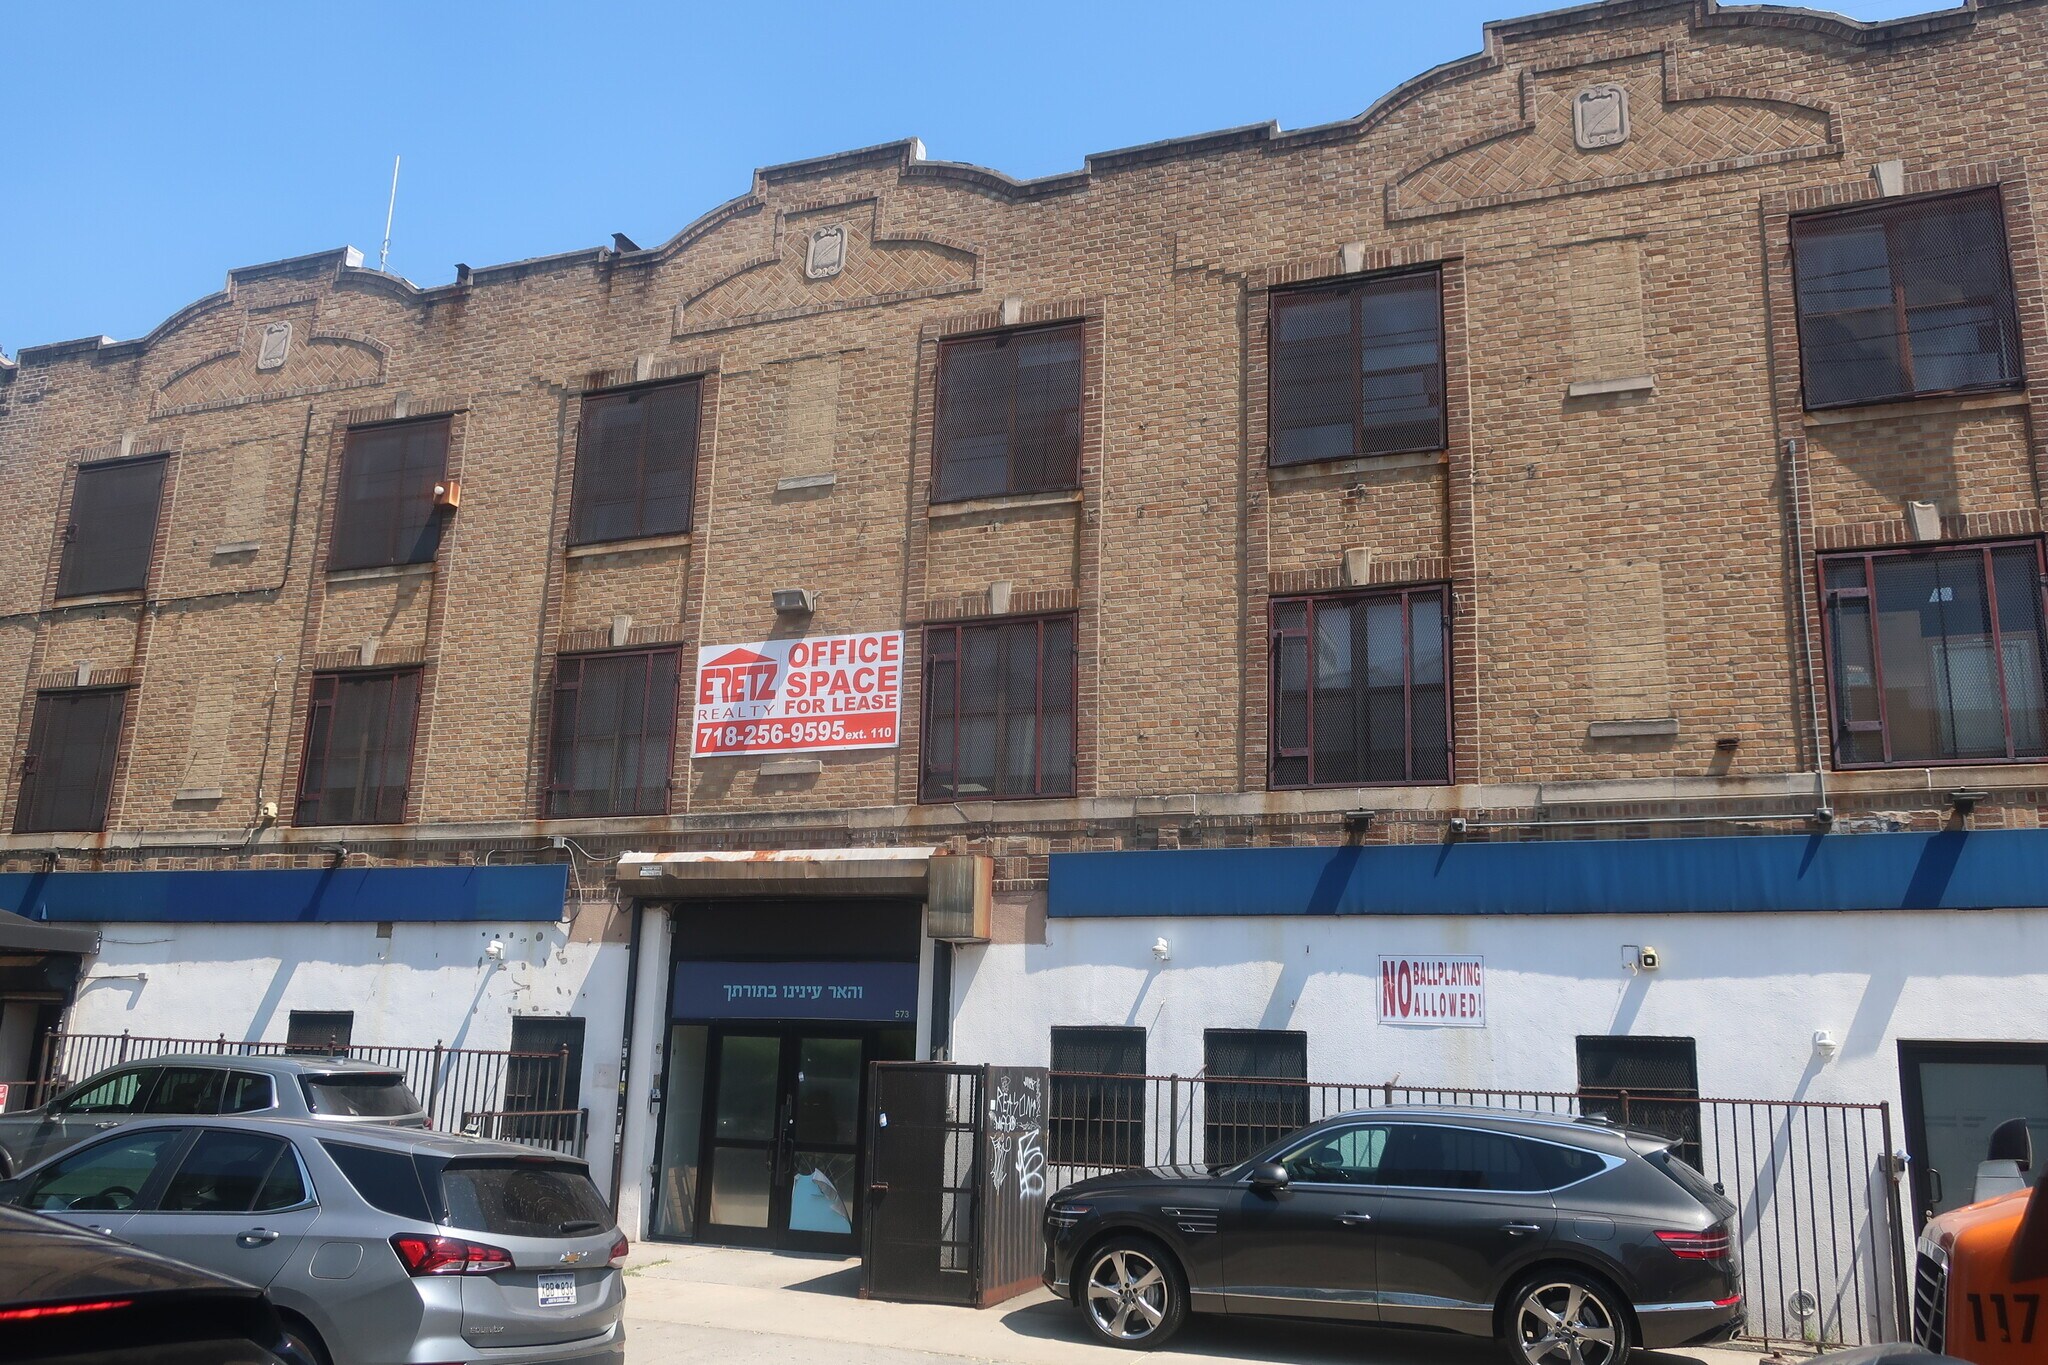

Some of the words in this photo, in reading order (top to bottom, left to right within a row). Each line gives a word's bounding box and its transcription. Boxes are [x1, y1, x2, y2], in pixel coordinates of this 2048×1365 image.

[788, 635, 899, 668] OFFICE
[699, 664, 778, 705] ERETZ
[786, 666, 898, 698] SPACE
[698, 704, 775, 721] REALTY
[784, 699, 825, 715] FOR
[832, 693, 897, 713] LEASE
[700, 720, 845, 748] 718-256-9595
[845, 729, 867, 740] ext.
[870, 726, 892, 739] 110
[1413, 961, 1481, 987] BALLPLAYING
[723, 984, 777, 1002] בתורתך
[783, 985, 823, 1000] עינינו
[828, 986, 863, 999] והאר
[1382, 960, 1412, 1018] NO
[894, 1010, 910, 1019] 573
[1414, 992, 1482, 1018] ALLOWED!
[1967, 1293, 2040, 1343] 117
